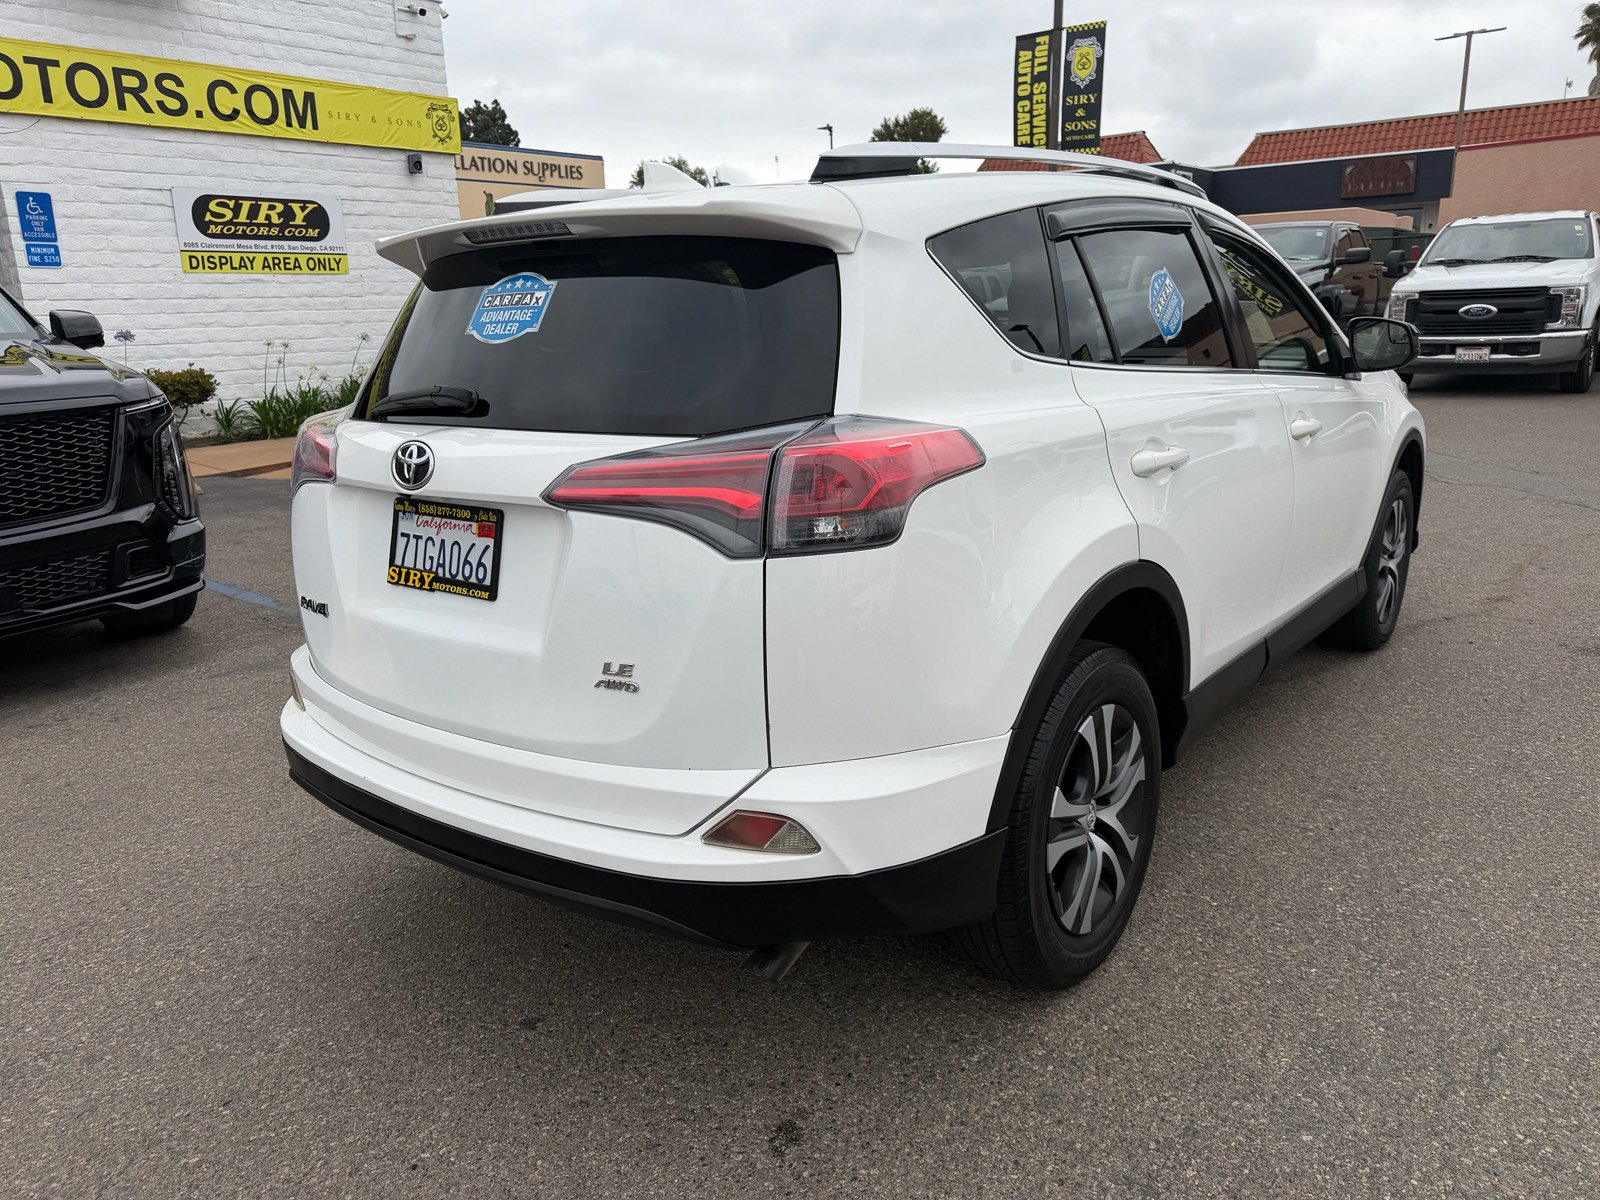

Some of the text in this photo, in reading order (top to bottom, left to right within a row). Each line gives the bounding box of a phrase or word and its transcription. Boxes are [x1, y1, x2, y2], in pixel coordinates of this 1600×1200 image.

[1016, 51, 1032, 145] AUTO CARE
[1032, 35, 1049, 149] FULL SERVIC
[1065, 94, 1098, 106] SIRY
[328, 111, 361, 122] SIRY
[387, 117, 422, 129] SONS
[1075, 108, 1086, 117] &
[1064, 120, 1097, 132] SONS
[522, 160, 583, 181] SUPPLIES
[204, 198, 318, 226] SIRY
[24, 231, 56, 239] ACCESSIBLE
[206, 224, 321, 238] MOTORS.COM
[200, 242, 235, 250] Clairemont
[253, 243, 269, 251] Blvd,
[300, 244, 319, 252] Diego,
[28, 255, 41, 263] FINE
[188, 255, 342, 272] DISPLAY AREA ONLY
[483, 294, 543, 309] CARFAX
[480, 309, 534, 323] ADVANTAGE
[483, 322, 519, 335] DEALER
[418, 502, 437, 514] (858)
[437, 506, 471, 519] 277-7300
[415, 514, 476, 536] California
[400, 532, 491, 584] 7TGA066
[387, 566, 436, 590] SIRY
[300, 595, 330, 618] RAV4
[601, 661, 635, 678] LE
[593, 679, 640, 693] AWD
